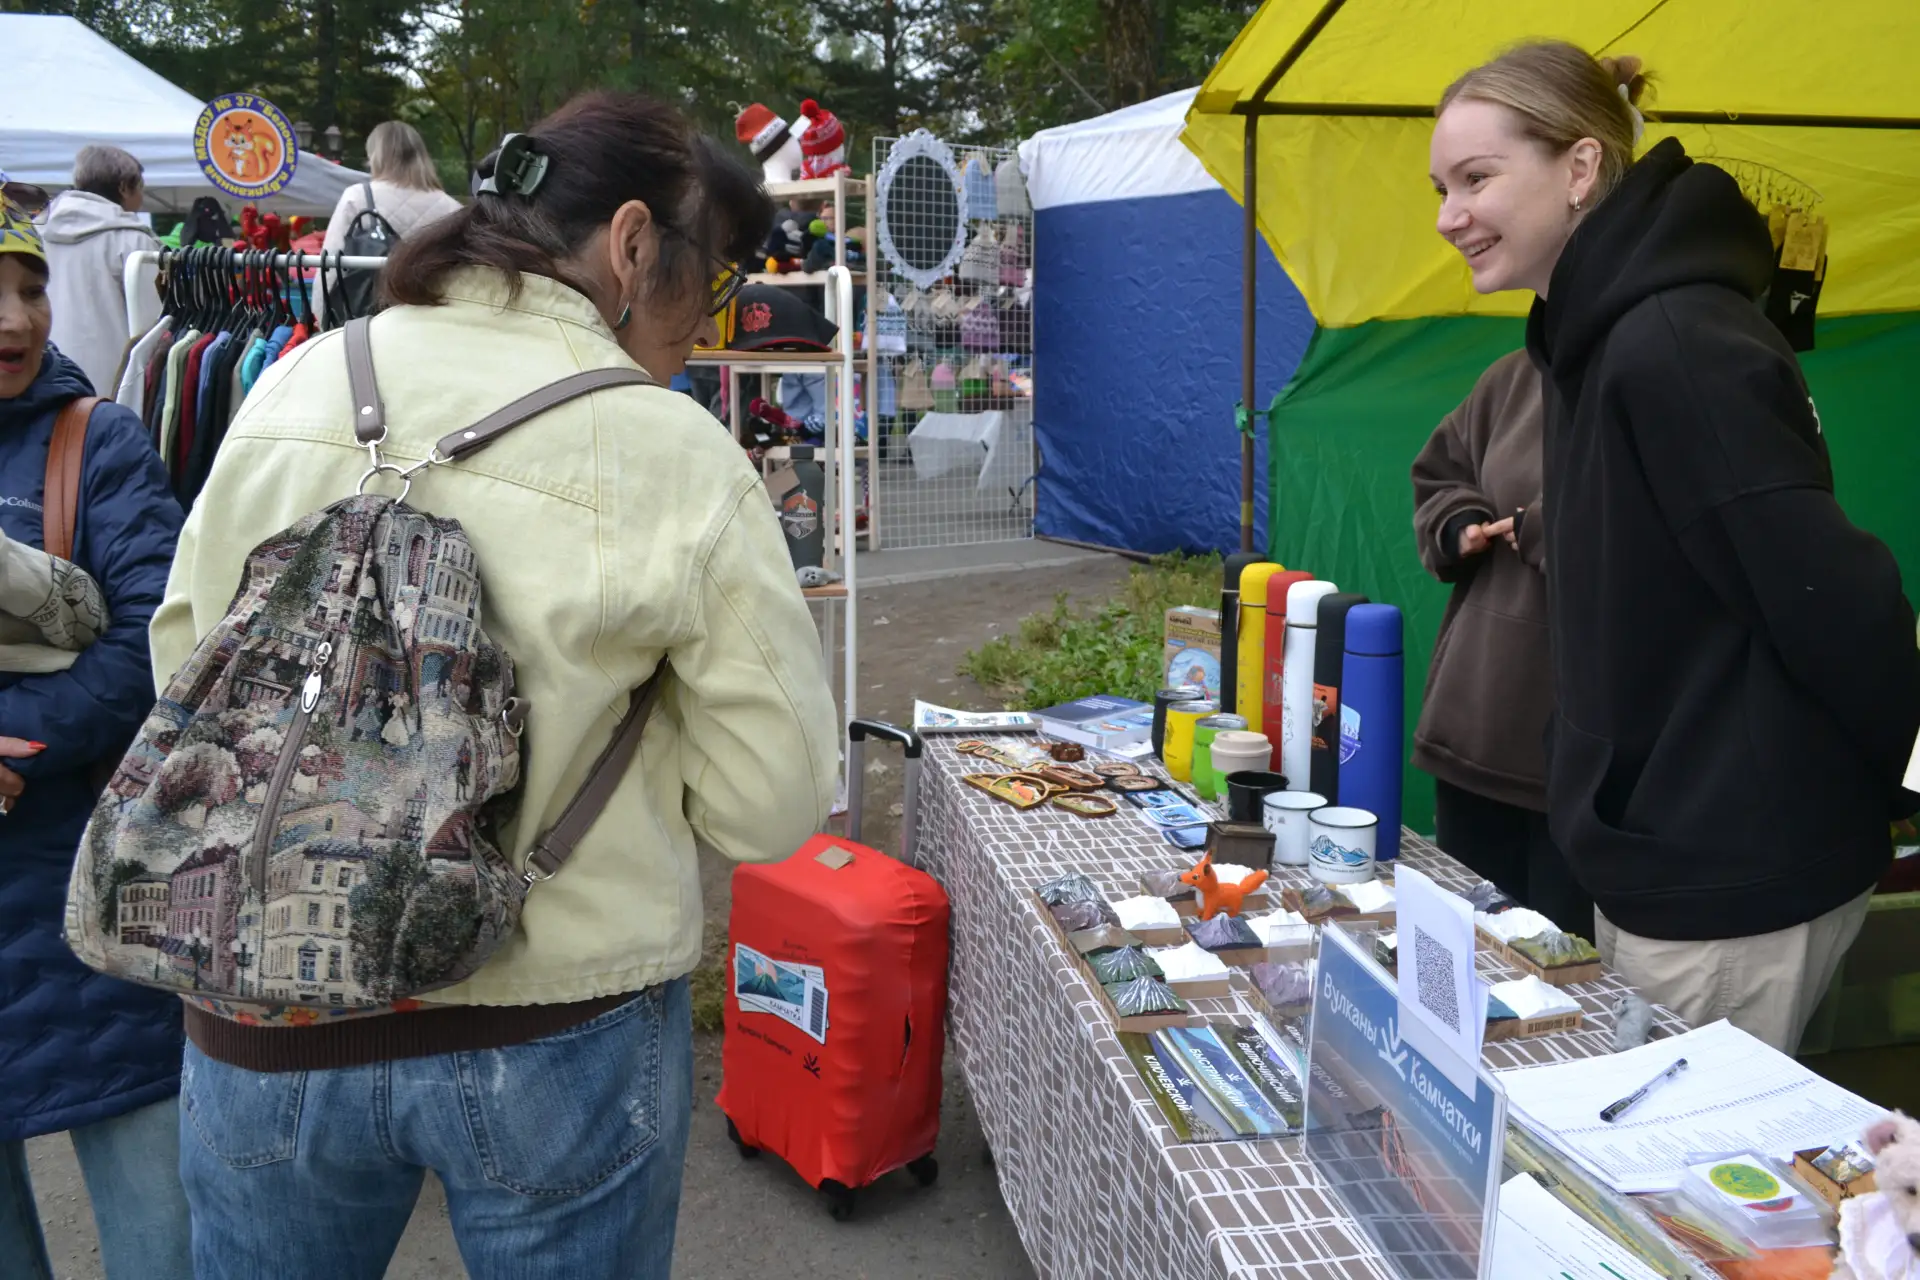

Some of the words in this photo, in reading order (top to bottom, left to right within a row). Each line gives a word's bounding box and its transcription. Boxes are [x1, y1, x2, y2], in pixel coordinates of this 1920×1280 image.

[236, 95, 253, 107] 37
[7, 496, 44, 512] Colum
[1143, 1055, 1194, 1111] КЛЮЧЕВСКОЙ
[1189, 1048, 1250, 1108] БЫСТРИНСКИЙ
[1237, 1042, 1299, 1103] ВИЛЮЧИНСКИЙ
[1323, 972, 1378, 1046] Вулканы
[1410, 1056, 1482, 1154] Камчатки
